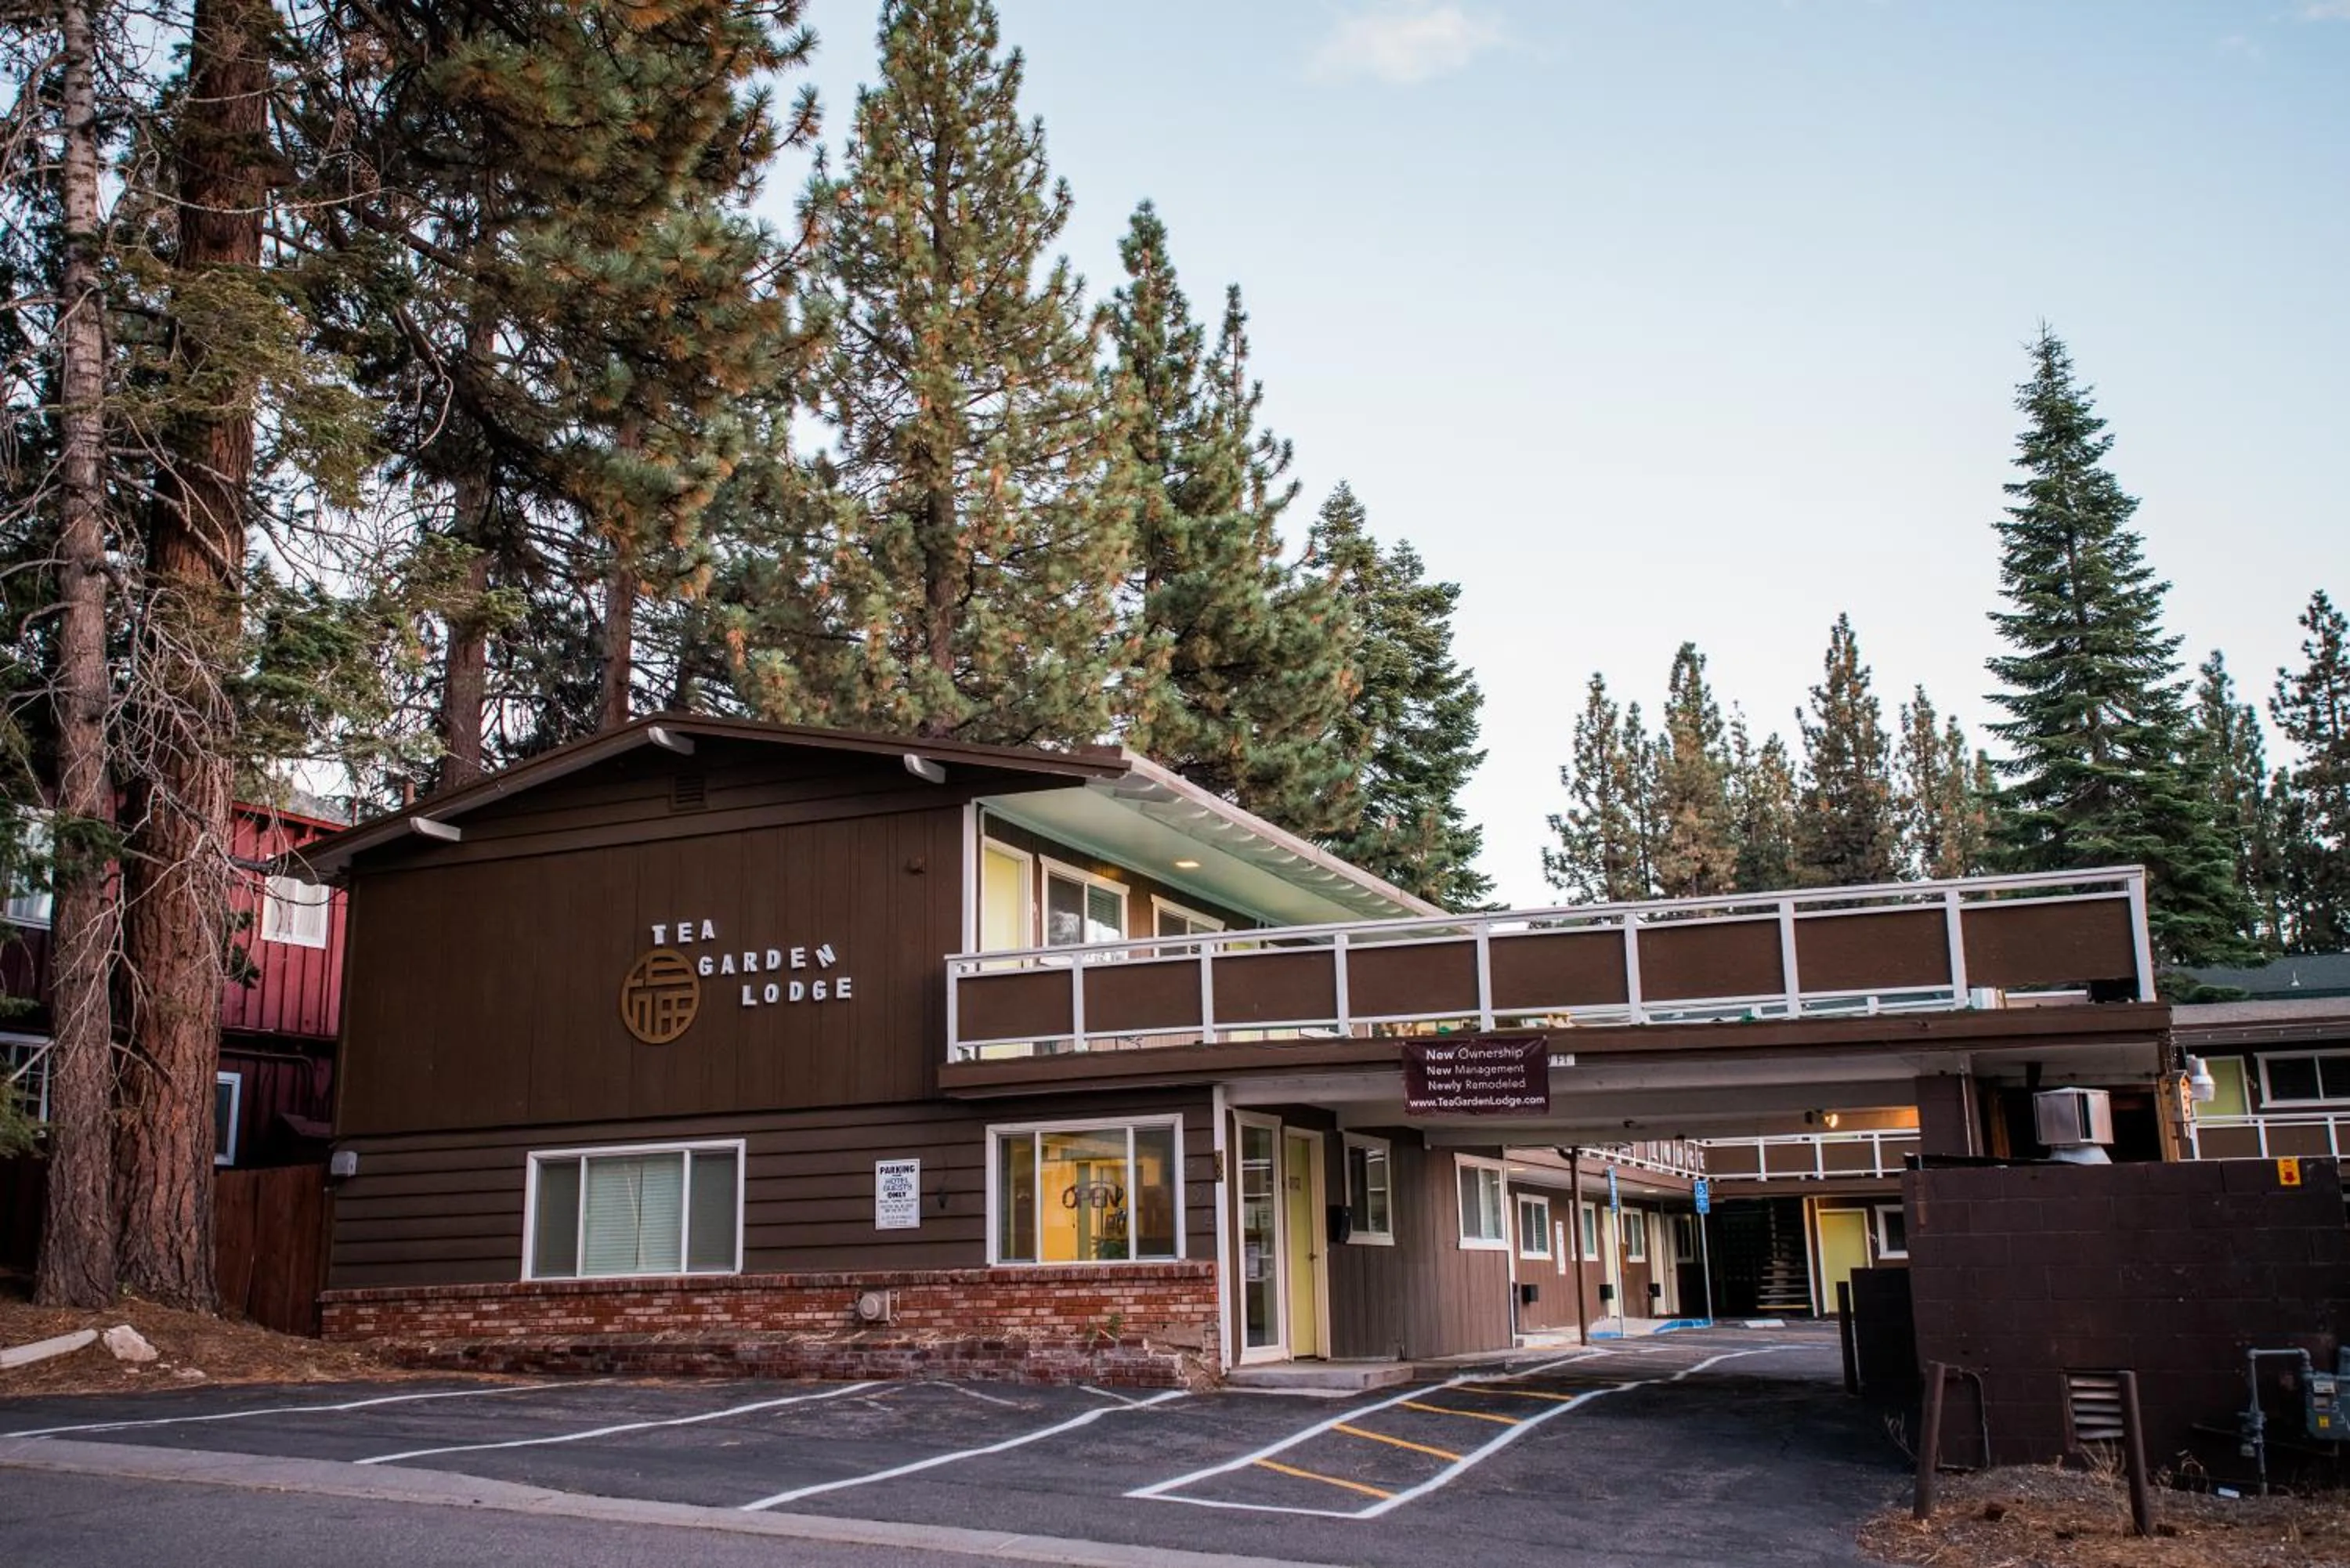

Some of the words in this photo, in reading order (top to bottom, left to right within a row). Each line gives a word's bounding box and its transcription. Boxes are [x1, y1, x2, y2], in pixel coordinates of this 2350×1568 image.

[652, 919, 715, 945] TEA
[698, 945, 836, 976] GARDEN
[742, 977, 851, 1006] LODGE
[1426, 1049, 1455, 1060] New
[1458, 1046, 1524, 1060] Ownership
[1426, 1064, 1452, 1075] New
[1455, 1064, 1524, 1077] Management
[1428, 1079, 1462, 1093] Newly
[1466, 1077, 1526, 1090] Remodeled
[1409, 1095, 1546, 1107] www.TeaGardenLodge.com
[880, 1165, 915, 1175] PARKING
